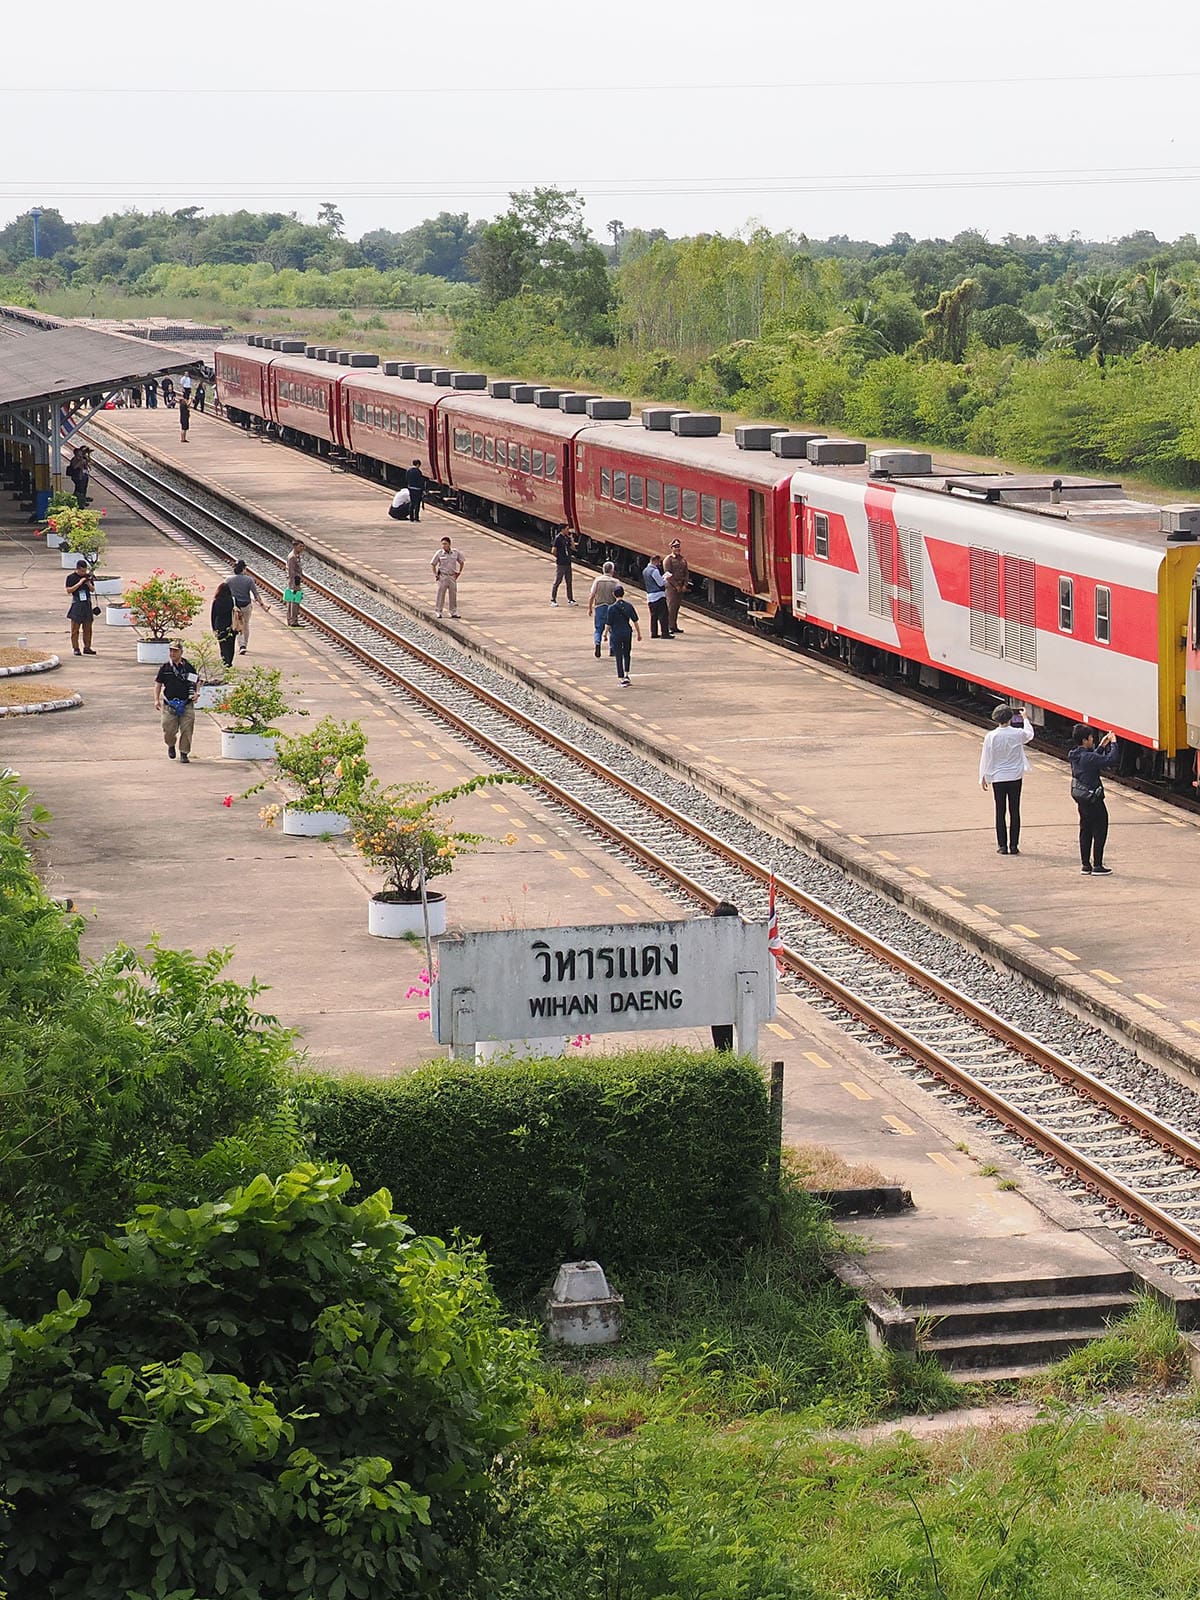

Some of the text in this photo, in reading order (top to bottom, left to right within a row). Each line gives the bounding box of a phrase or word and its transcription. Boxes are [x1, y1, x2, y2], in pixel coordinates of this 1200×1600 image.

[531, 941, 679, 983] วิหารแดง
[528, 989, 683, 1018] WIHAN DAENG
